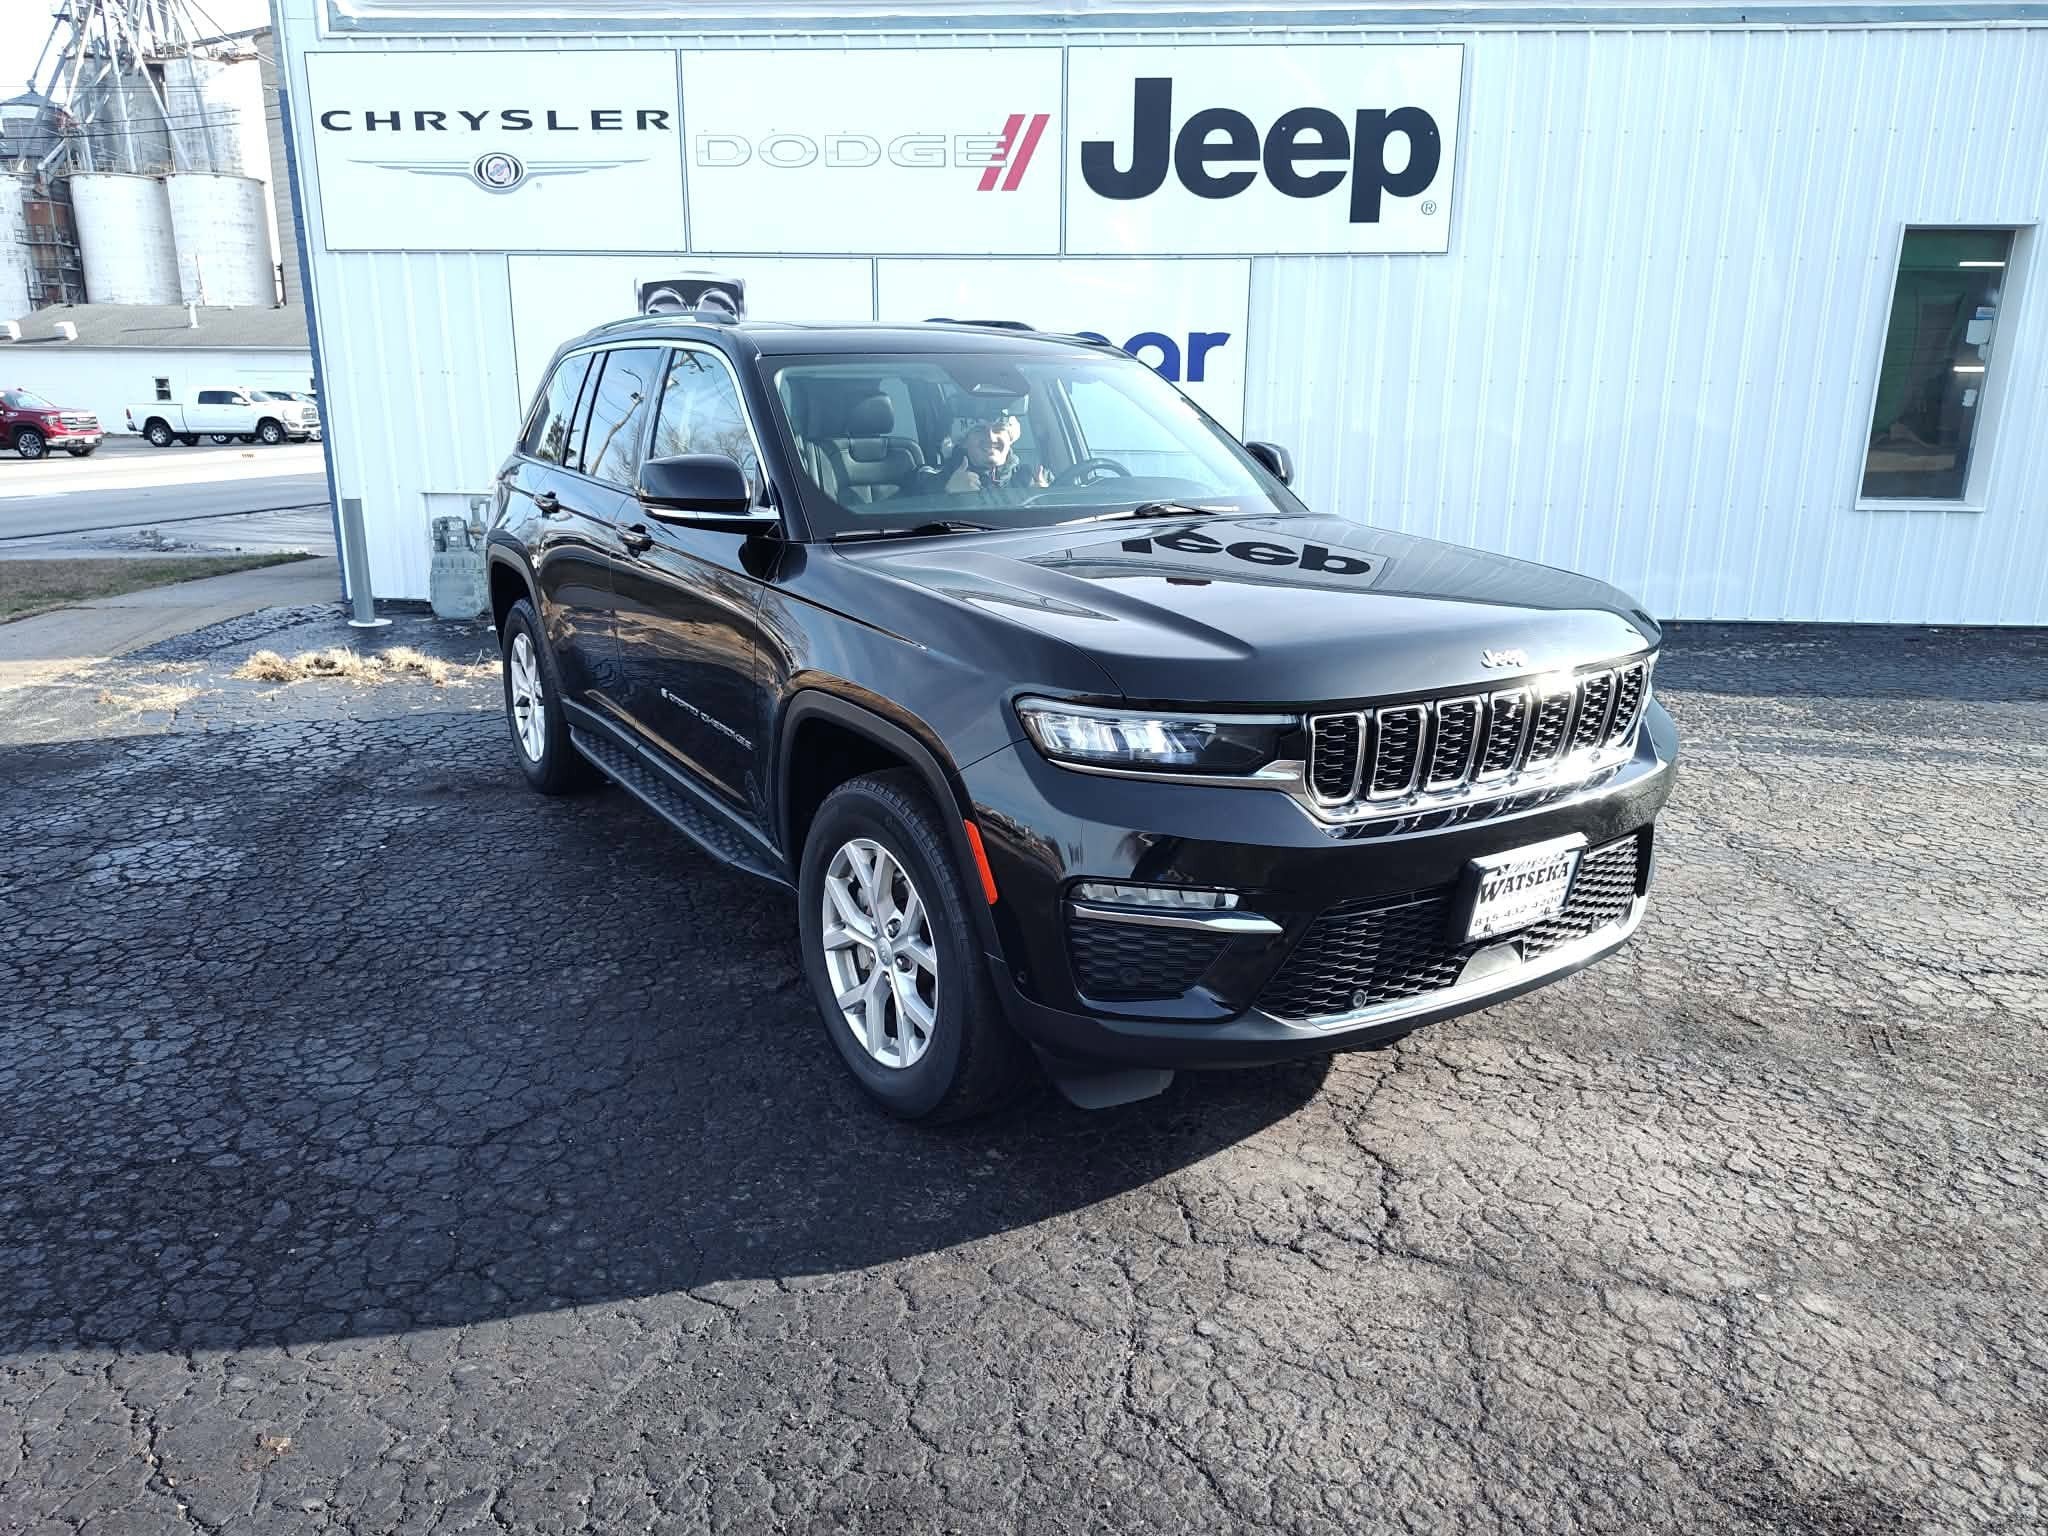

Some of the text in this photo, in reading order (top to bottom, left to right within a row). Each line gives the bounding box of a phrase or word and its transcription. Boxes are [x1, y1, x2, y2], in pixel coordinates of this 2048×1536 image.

[320, 108, 671, 132] CHRYSLER
[696, 134, 1008, 168] DODGE
[1082, 77, 1441, 223] Jeep
[1480, 861, 1570, 905] WATSEKA
